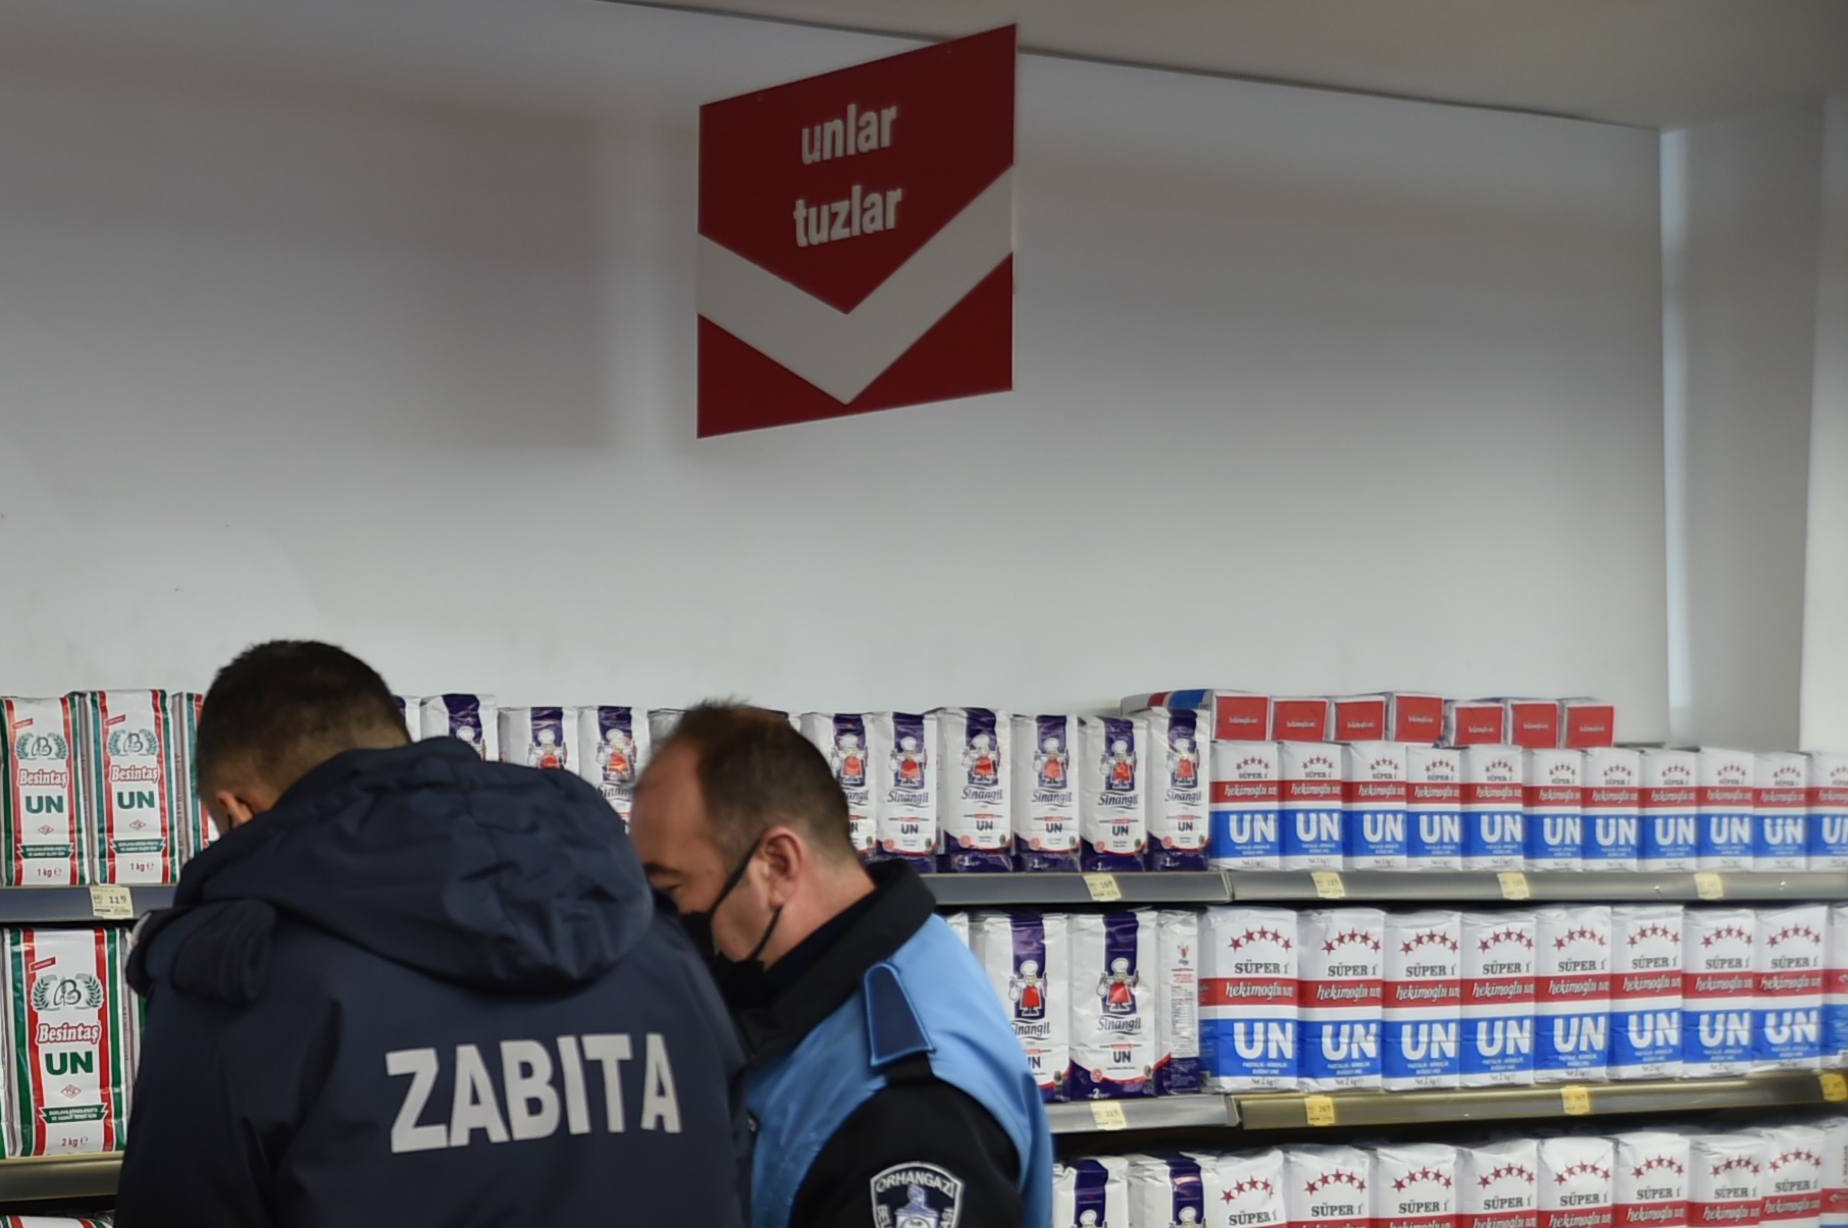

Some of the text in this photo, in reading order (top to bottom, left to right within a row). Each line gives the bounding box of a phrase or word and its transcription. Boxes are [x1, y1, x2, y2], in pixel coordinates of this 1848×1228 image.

[801, 104, 897, 165] unlar
[793, 185, 902, 247] tuzlar
[108, 765, 161, 784] Besintaş
[117, 791, 155, 810] UN
[976, 820, 993, 831] UN
[1229, 814, 1275, 843] UN
[1655, 818, 1696, 845] UN
[1234, 960, 1280, 974] SÜPER
[1328, 962, 1368, 977] SÜPER
[36, 1020, 102, 1045] Besintaş
[1097, 1017, 1142, 1032] Sinangil
[1233, 1022, 1293, 1060] UN
[1321, 1023, 1377, 1061] UN
[45, 1051, 94, 1075] UN
[1113, 1051, 1131, 1063] UN
[385, 1033, 682, 1153] ZABITA
[1398, 1200, 1440, 1214] SÜPER
[1228, 1212, 1271, 1226] SÜPER
